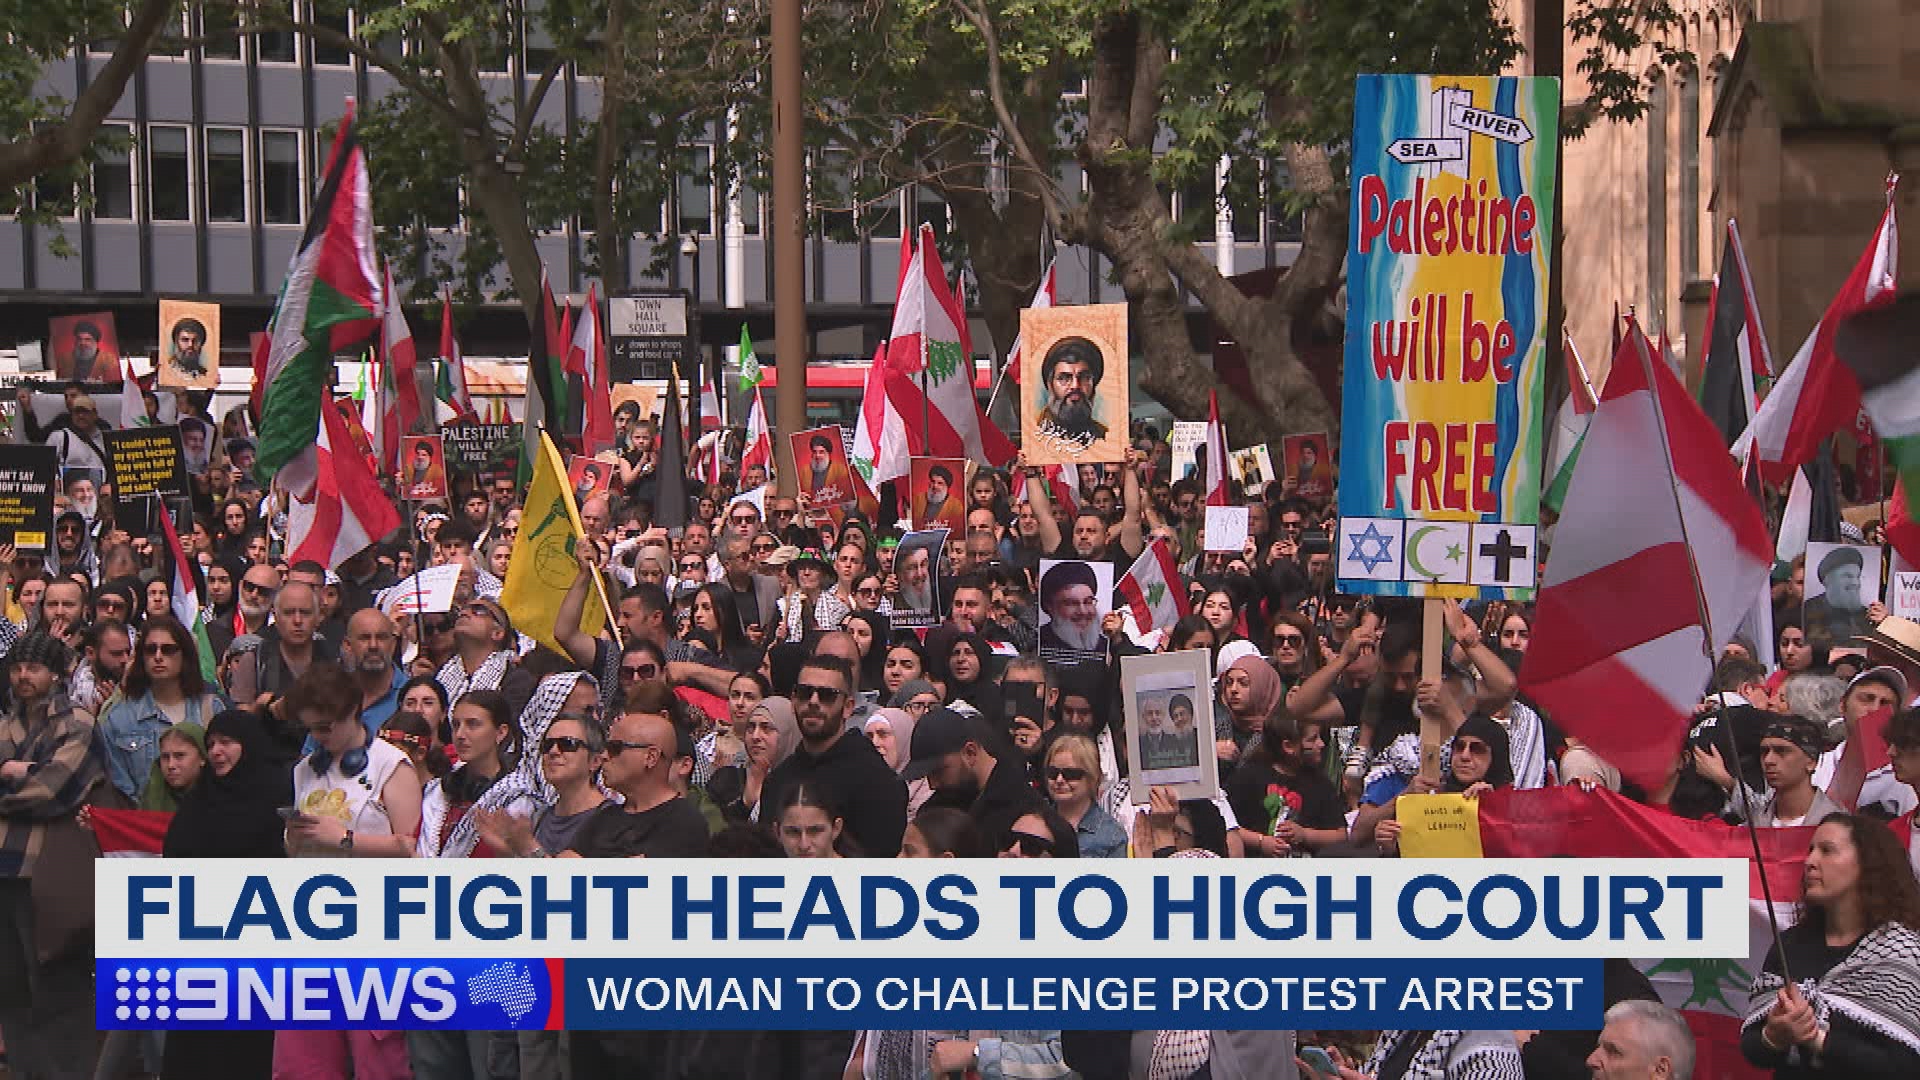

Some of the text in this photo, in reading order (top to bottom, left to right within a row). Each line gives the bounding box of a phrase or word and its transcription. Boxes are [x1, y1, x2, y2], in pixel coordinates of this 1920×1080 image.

[1462, 110, 1520, 136] RIVER
[1400, 143, 1437, 156] SEA
[1359, 174, 1536, 257] Palestine
[633, 299, 661, 310] TOWN
[635, 311, 659, 321] HALL
[628, 323, 667, 334] SQUARE
[1372, 291, 1514, 383] will be
[629, 350, 644, 358] and
[645, 350, 662, 358] food
[441, 426, 510, 441] PALESTINE
[458, 442, 481, 451] WILL
[145, 448, 176, 457] because
[464, 452, 487, 461] FREE
[1384, 421, 1498, 513] FREE
[19, 471, 34, 481] SAY
[22, 484, 46, 494] KNOW
